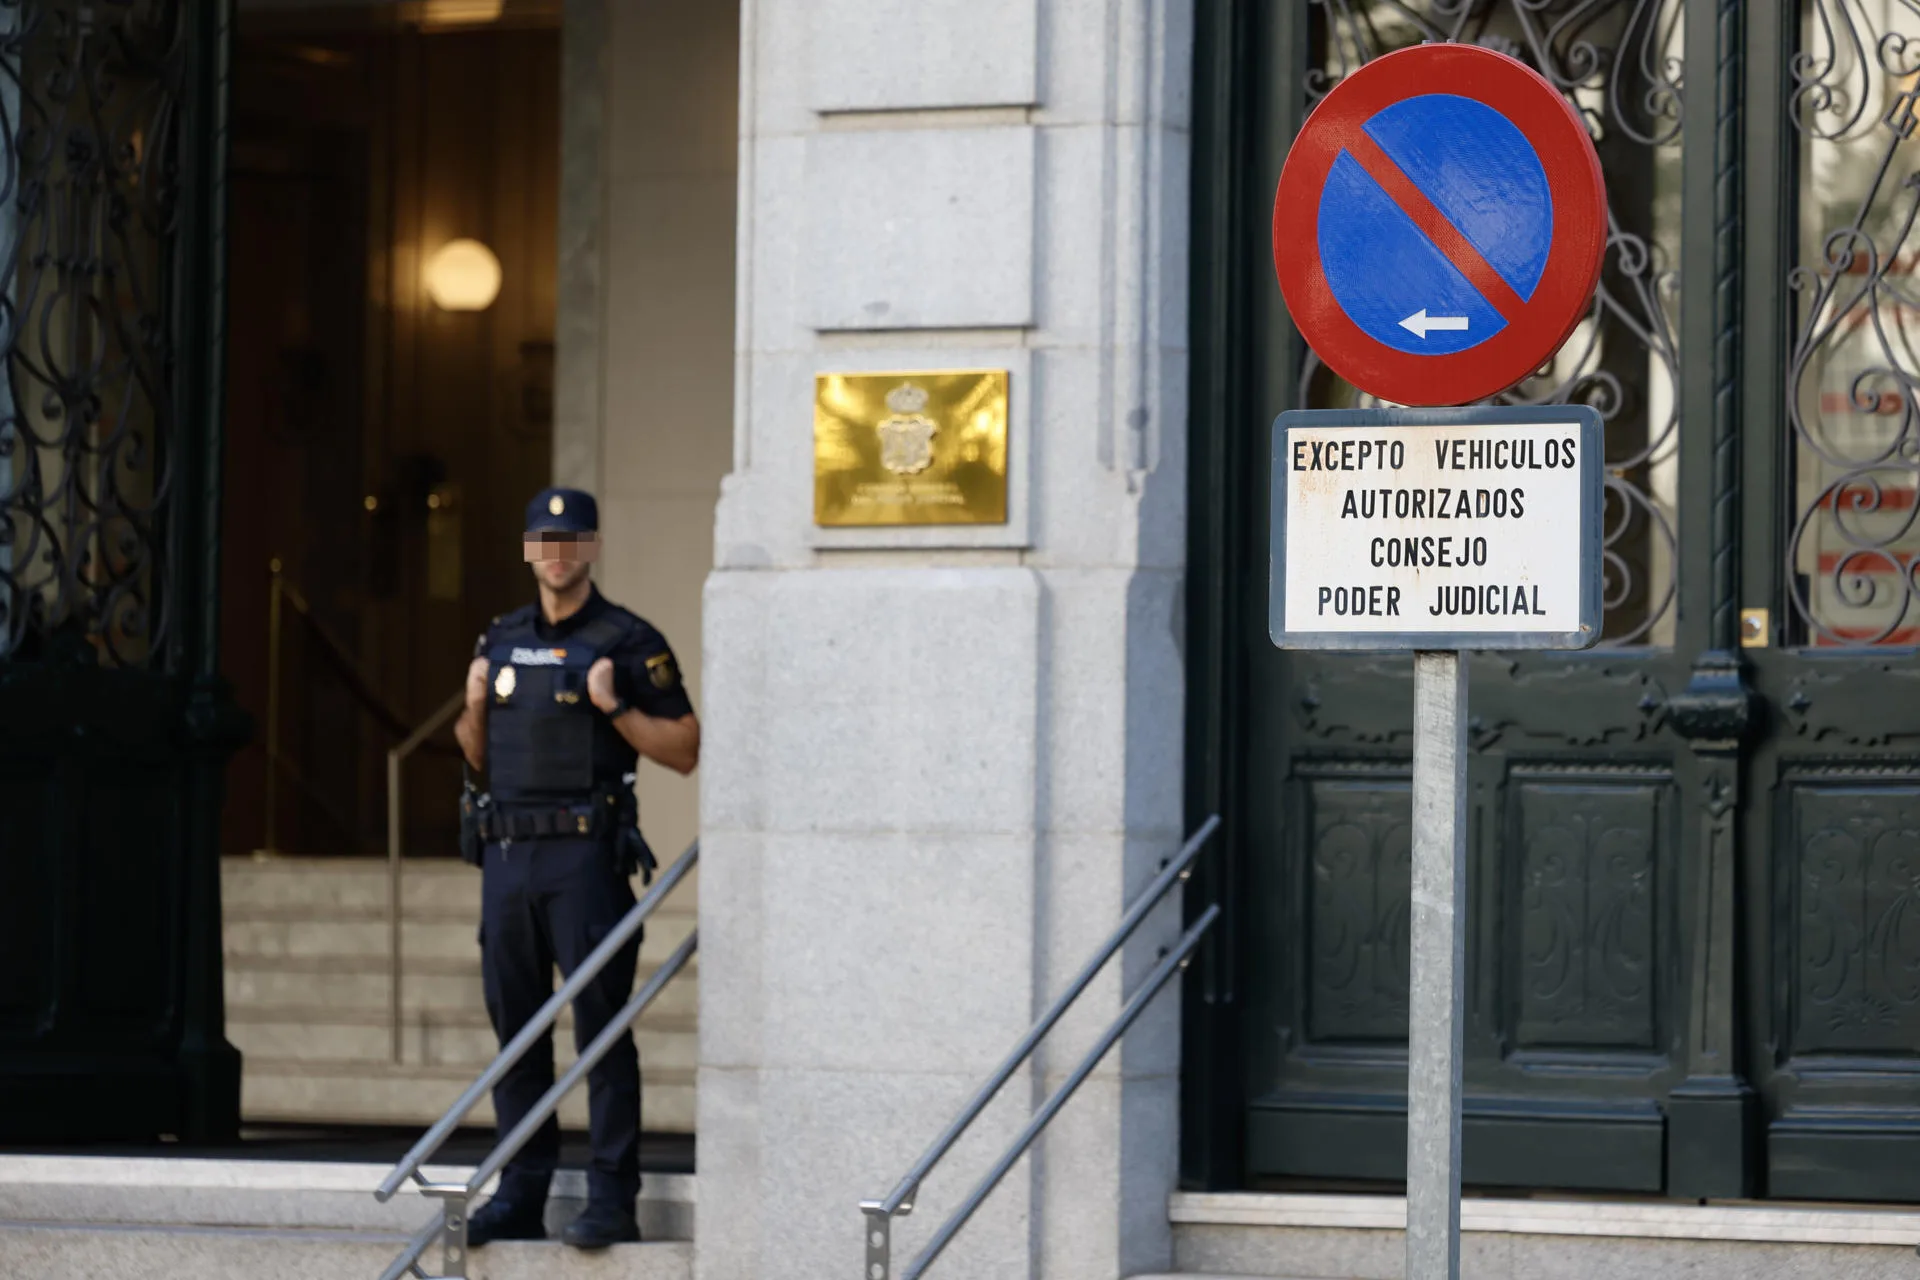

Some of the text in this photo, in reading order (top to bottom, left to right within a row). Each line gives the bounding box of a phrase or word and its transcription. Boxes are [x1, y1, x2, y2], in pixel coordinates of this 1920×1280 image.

[1293, 438, 1576, 472] EXCEPTO VEHICULOS
[1341, 487, 1525, 519] AUTORIZADOS
[1370, 536, 1487, 568] CONSEJO
[1318, 584, 1546, 616] PODER JUDICIAL
